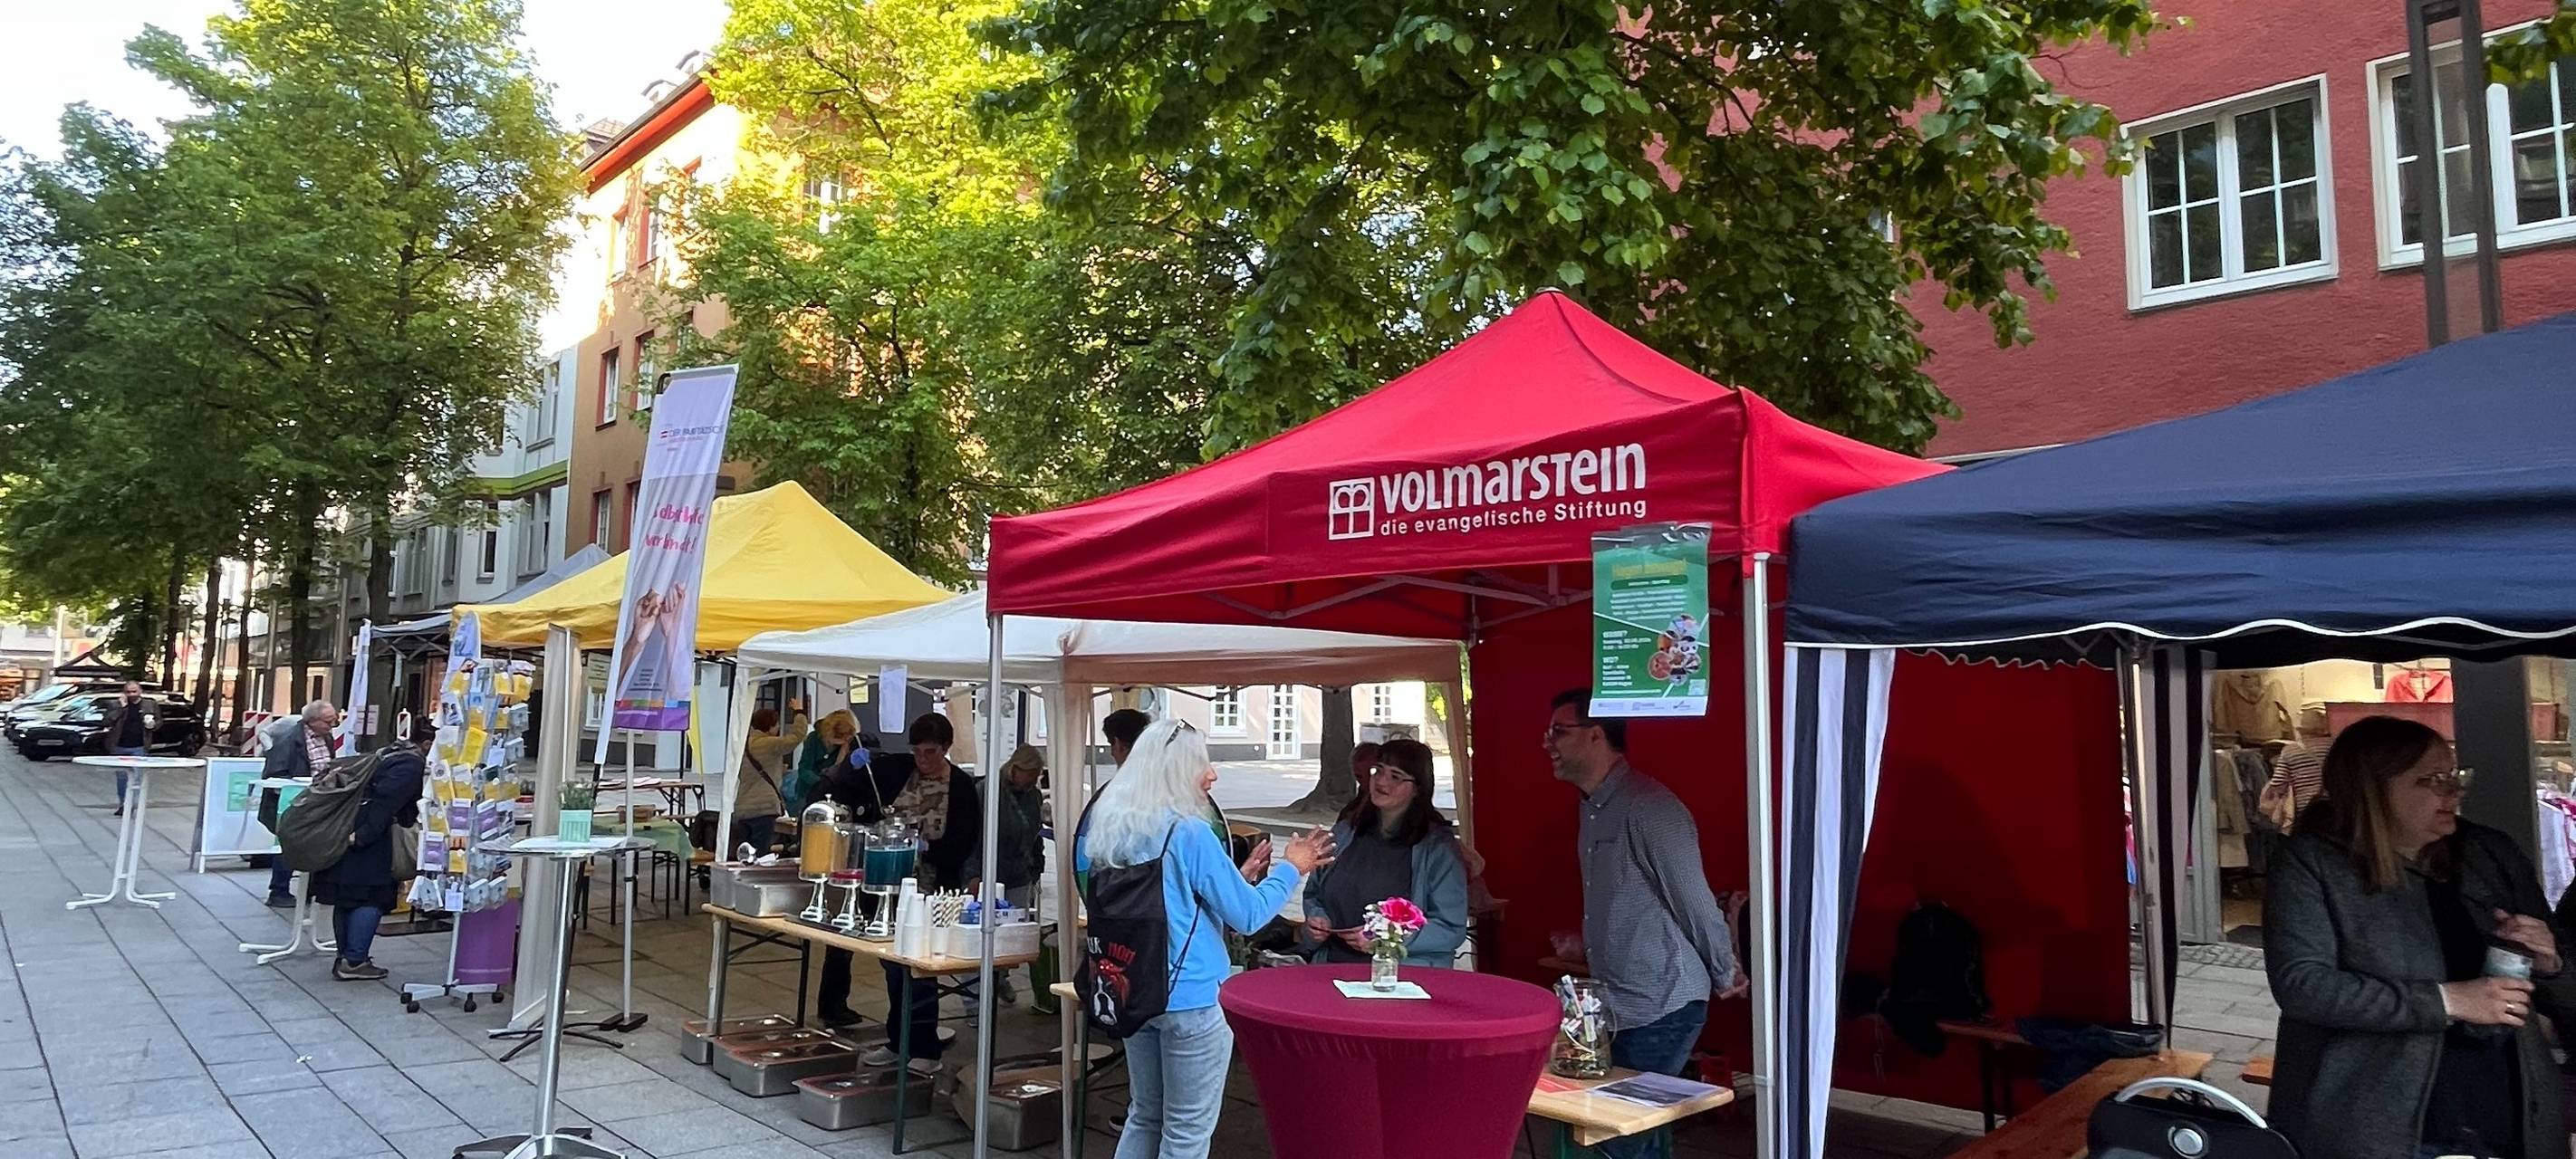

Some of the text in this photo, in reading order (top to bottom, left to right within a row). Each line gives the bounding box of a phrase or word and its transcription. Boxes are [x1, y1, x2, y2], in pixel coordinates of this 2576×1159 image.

[1380, 499, 1647, 536] die evangelische Stiftung
